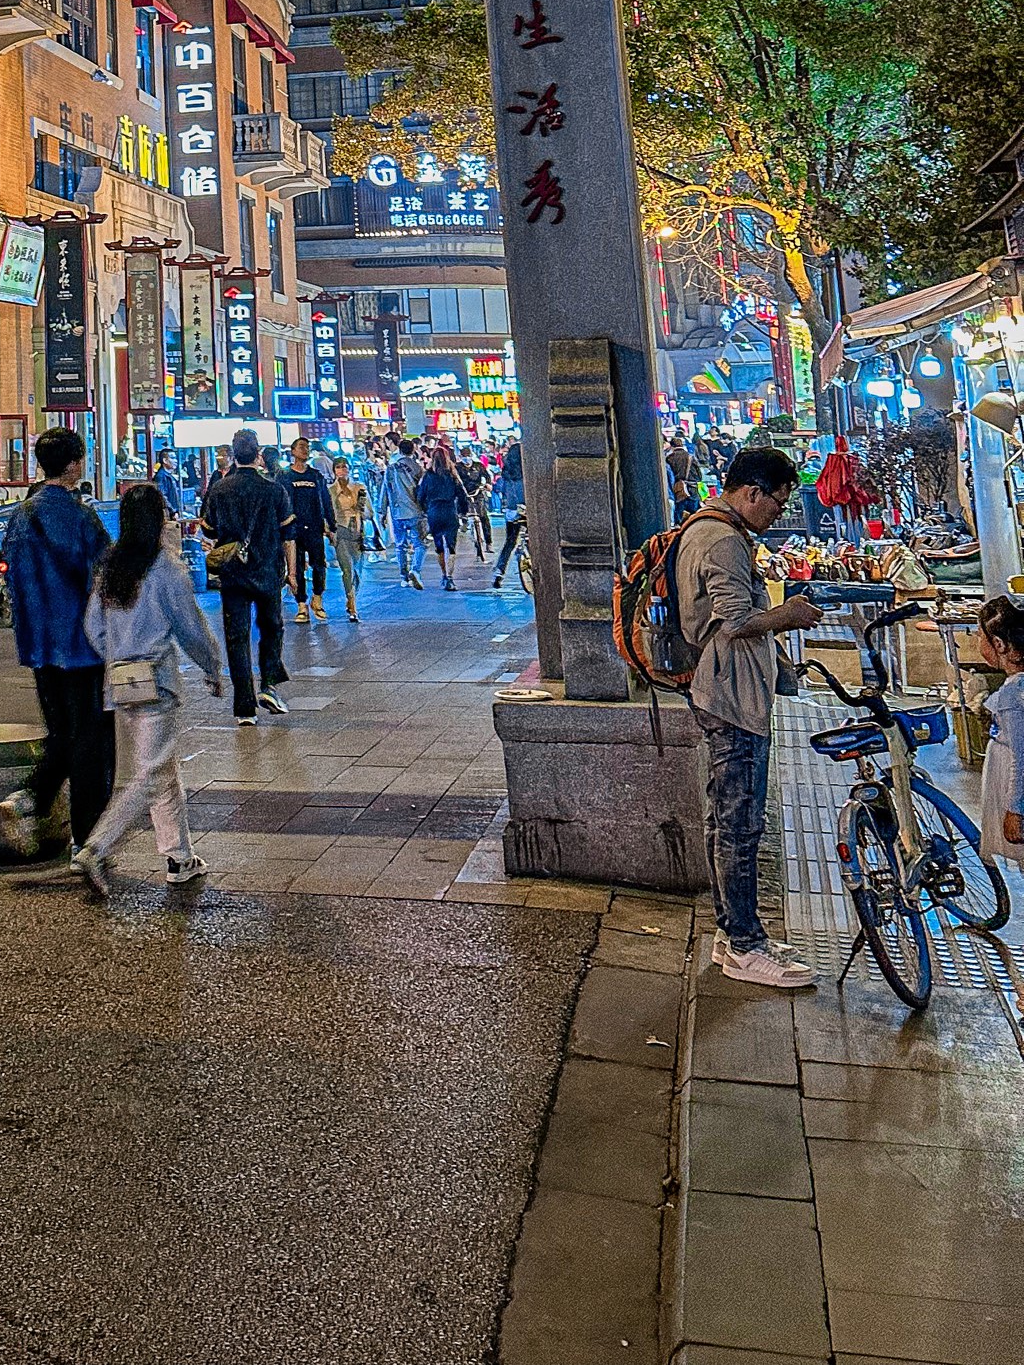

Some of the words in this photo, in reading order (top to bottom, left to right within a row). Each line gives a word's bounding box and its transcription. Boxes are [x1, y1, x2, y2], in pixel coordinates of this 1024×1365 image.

[175, 40, 218, 197] 中百仓储
[388, 197, 424, 213] 足浴
[447, 191, 490, 211] 茶艺
[229, 304, 253, 385] 中百仓储
[315, 325, 338, 392] 中百仓储
